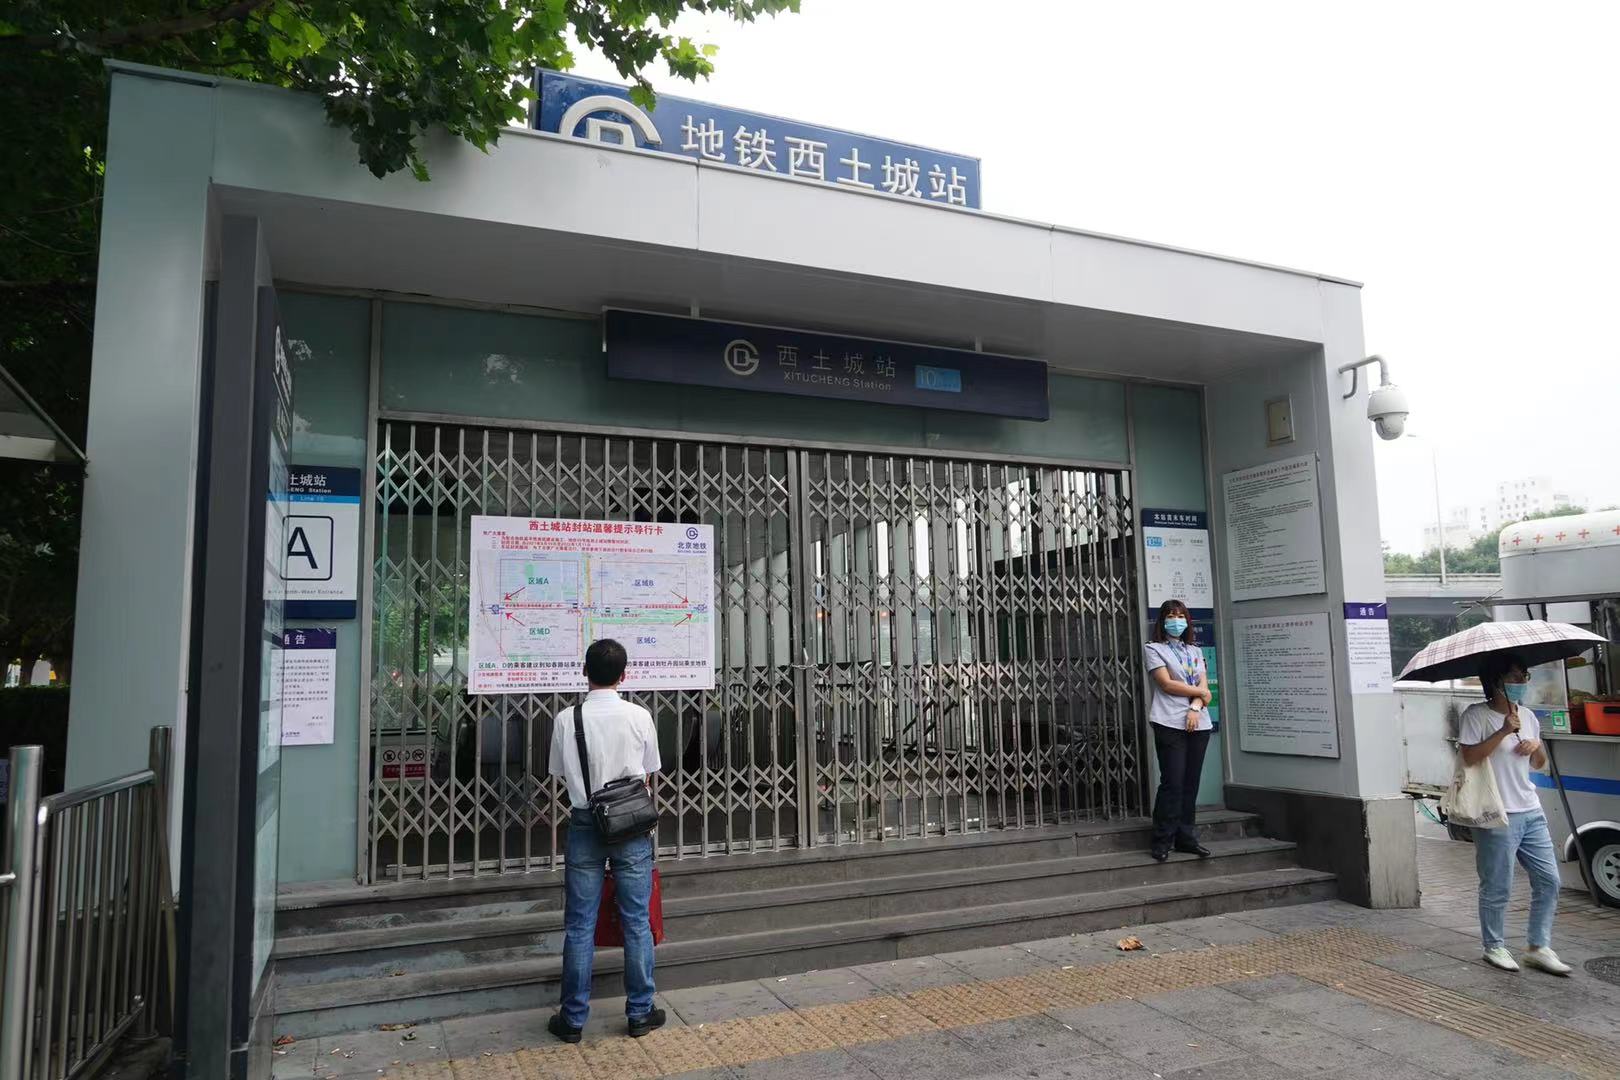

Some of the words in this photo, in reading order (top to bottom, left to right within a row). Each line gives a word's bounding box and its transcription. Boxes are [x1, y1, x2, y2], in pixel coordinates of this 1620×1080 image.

[680, 114, 968, 205] 地铁西土城站
[776, 344, 896, 378] 西土城站
[783, 371, 850, 388] XITUCHENG
[852, 379, 892, 392] Station
[529, 519, 664, 536] 西土城站封站温馨提示导行卡
[287, 526, 318, 570] A
[677, 541, 707, 550] 北京地铁
[528, 577, 550, 585] 区域A
[634, 579, 654, 587] 区域B
[529, 627, 551, 635] 区域D
